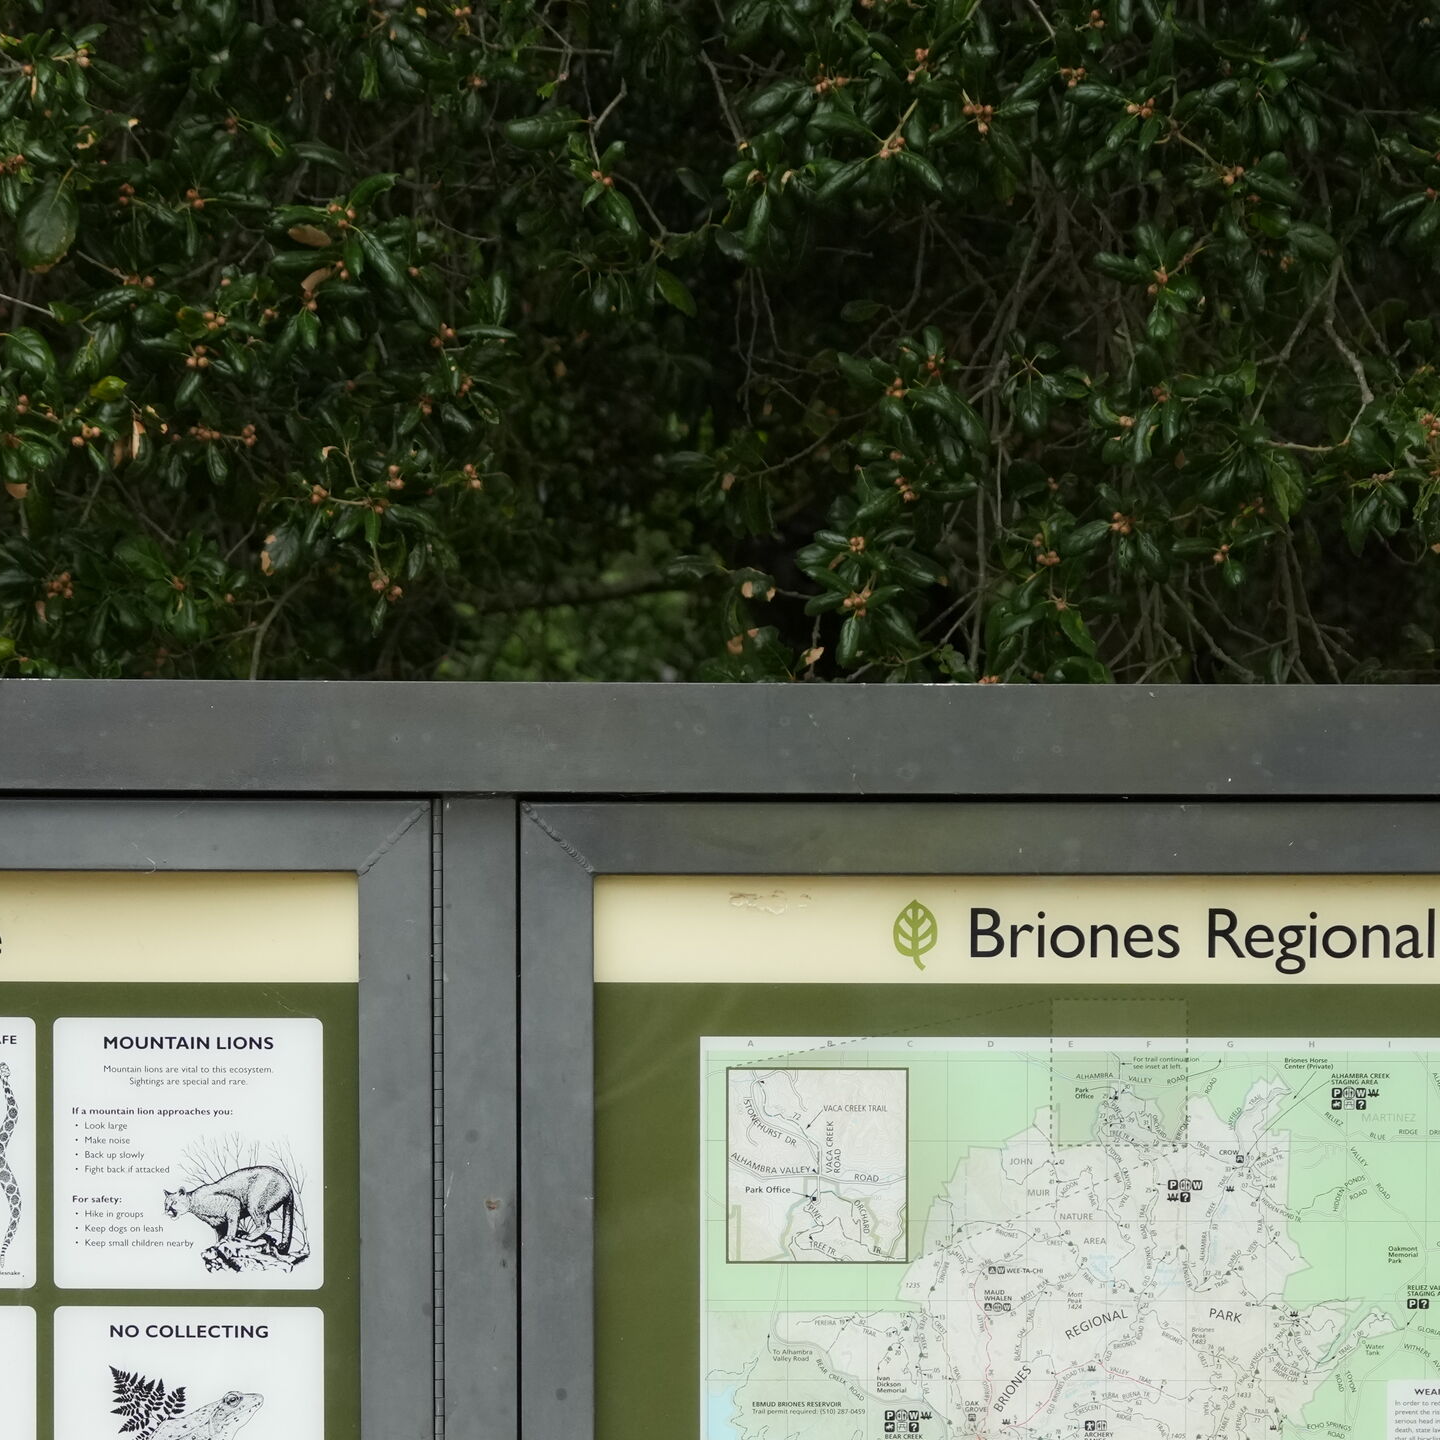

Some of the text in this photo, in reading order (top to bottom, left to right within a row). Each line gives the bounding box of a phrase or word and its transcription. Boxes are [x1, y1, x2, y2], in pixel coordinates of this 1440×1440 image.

[970, 907, 1181, 959] Briones
[1207, 907, 1436, 975] Regional
[103, 1036, 274, 1050] MOUNTAIN LIONS
[1331, 1072, 1390, 1080] ALHAMBRA CREEK
[84, 1121, 128, 1132] Look large
[84, 1136, 131, 1145] Make noise
[1209, 1307, 1242, 1324] PARK
[109, 1324, 269, 1339] NO COLLECTING
[1064, 1308, 1129, 1340] REGIONAL
[993, 1365, 1032, 1413] BRIONES
